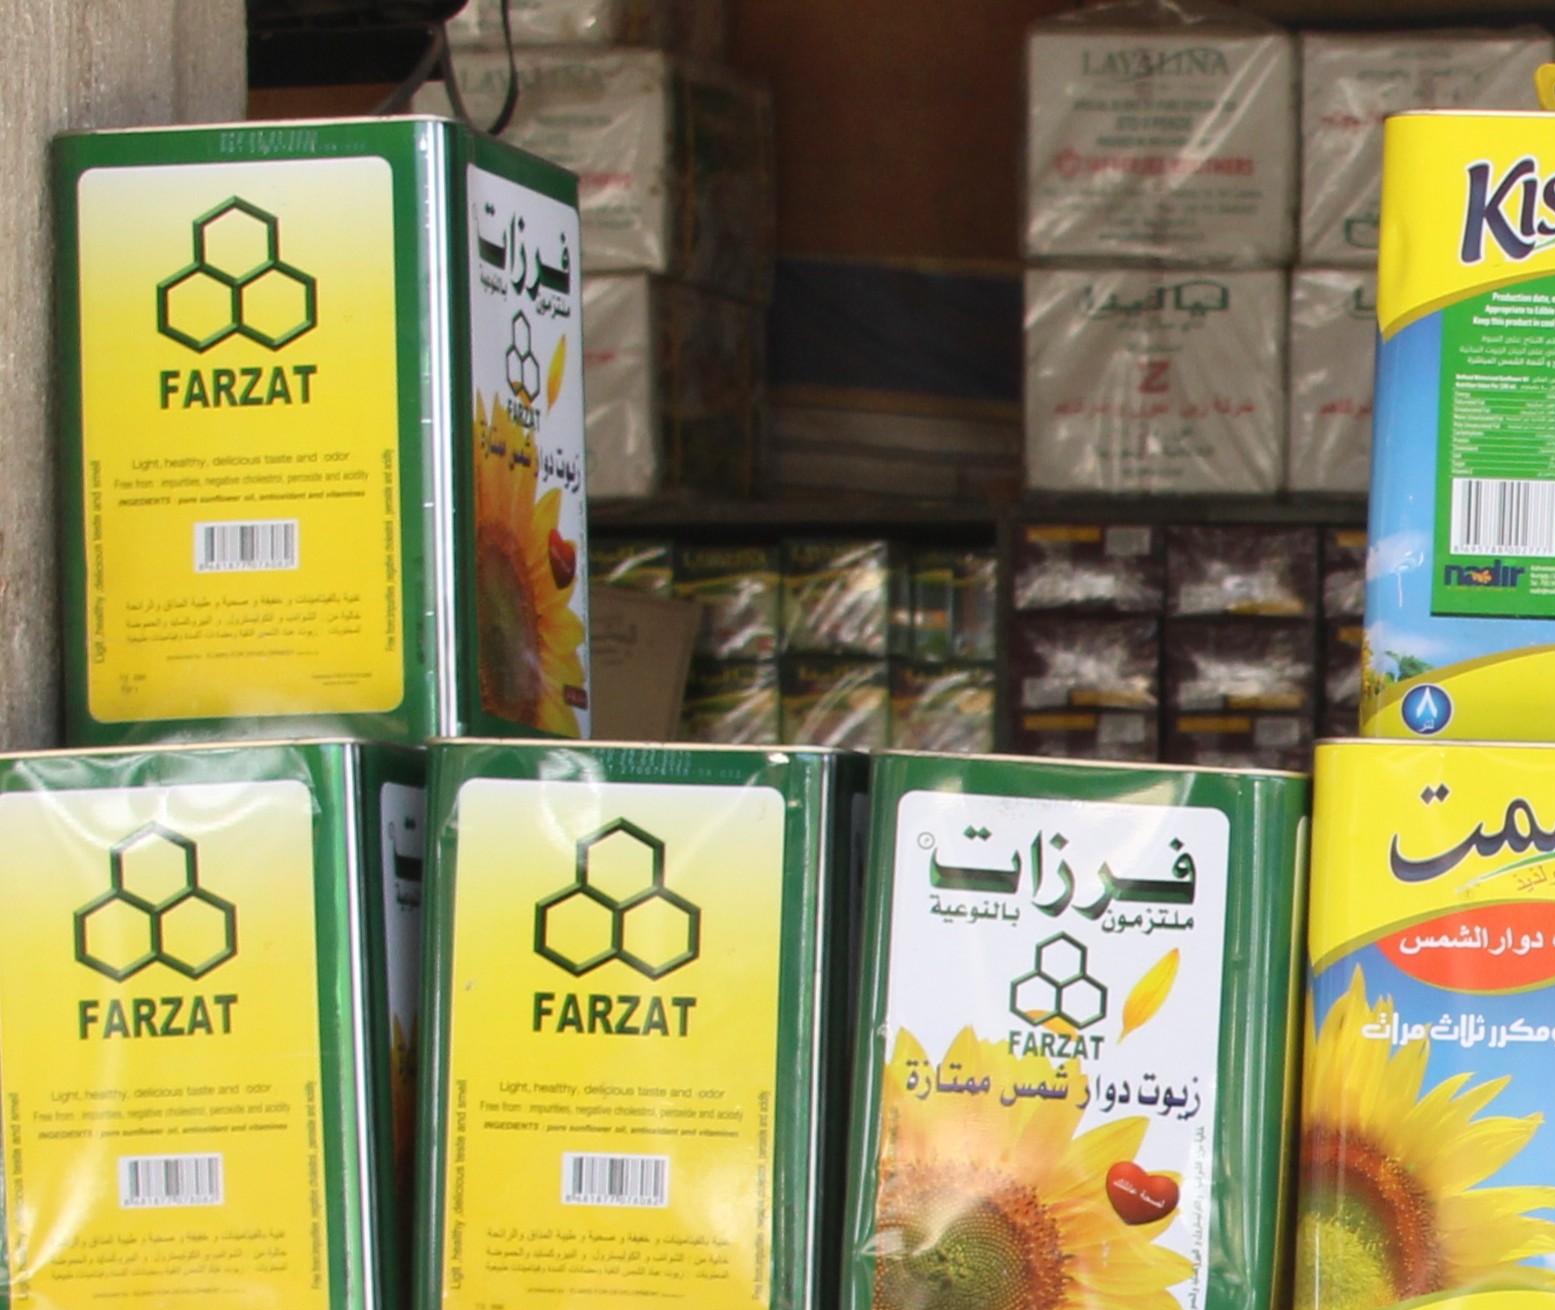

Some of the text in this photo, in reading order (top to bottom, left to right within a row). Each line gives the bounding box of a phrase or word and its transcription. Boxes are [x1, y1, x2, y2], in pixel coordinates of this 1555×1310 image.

[159, 365, 318, 410] FARZAT
[929, 825, 1198, 920] فرزات
[929, 894, 1195, 934] ملتزمون بالنوعية
[1399, 926, 1488, 956] الشمس
[1492, 929, 1544, 952] دوار
[78, 993, 239, 1040] FARZAT
[532, 992, 698, 1038] FARZAT
[1361, 1009, 1427, 1047] مرات
[1429, 1012, 1484, 1048] ثلاث
[1008, 1030, 1106, 1061] FARZAT
[499, 1082, 531, 1093] Light,
[533, 1083, 579, 1096] healthy,
[583, 1084, 635, 1097] delicious
[669, 1087, 693, 1098] and
[698, 1088, 726, 1099] odor
[904, 1058, 1201, 1122] زيوت دوار شمس ممتازة
